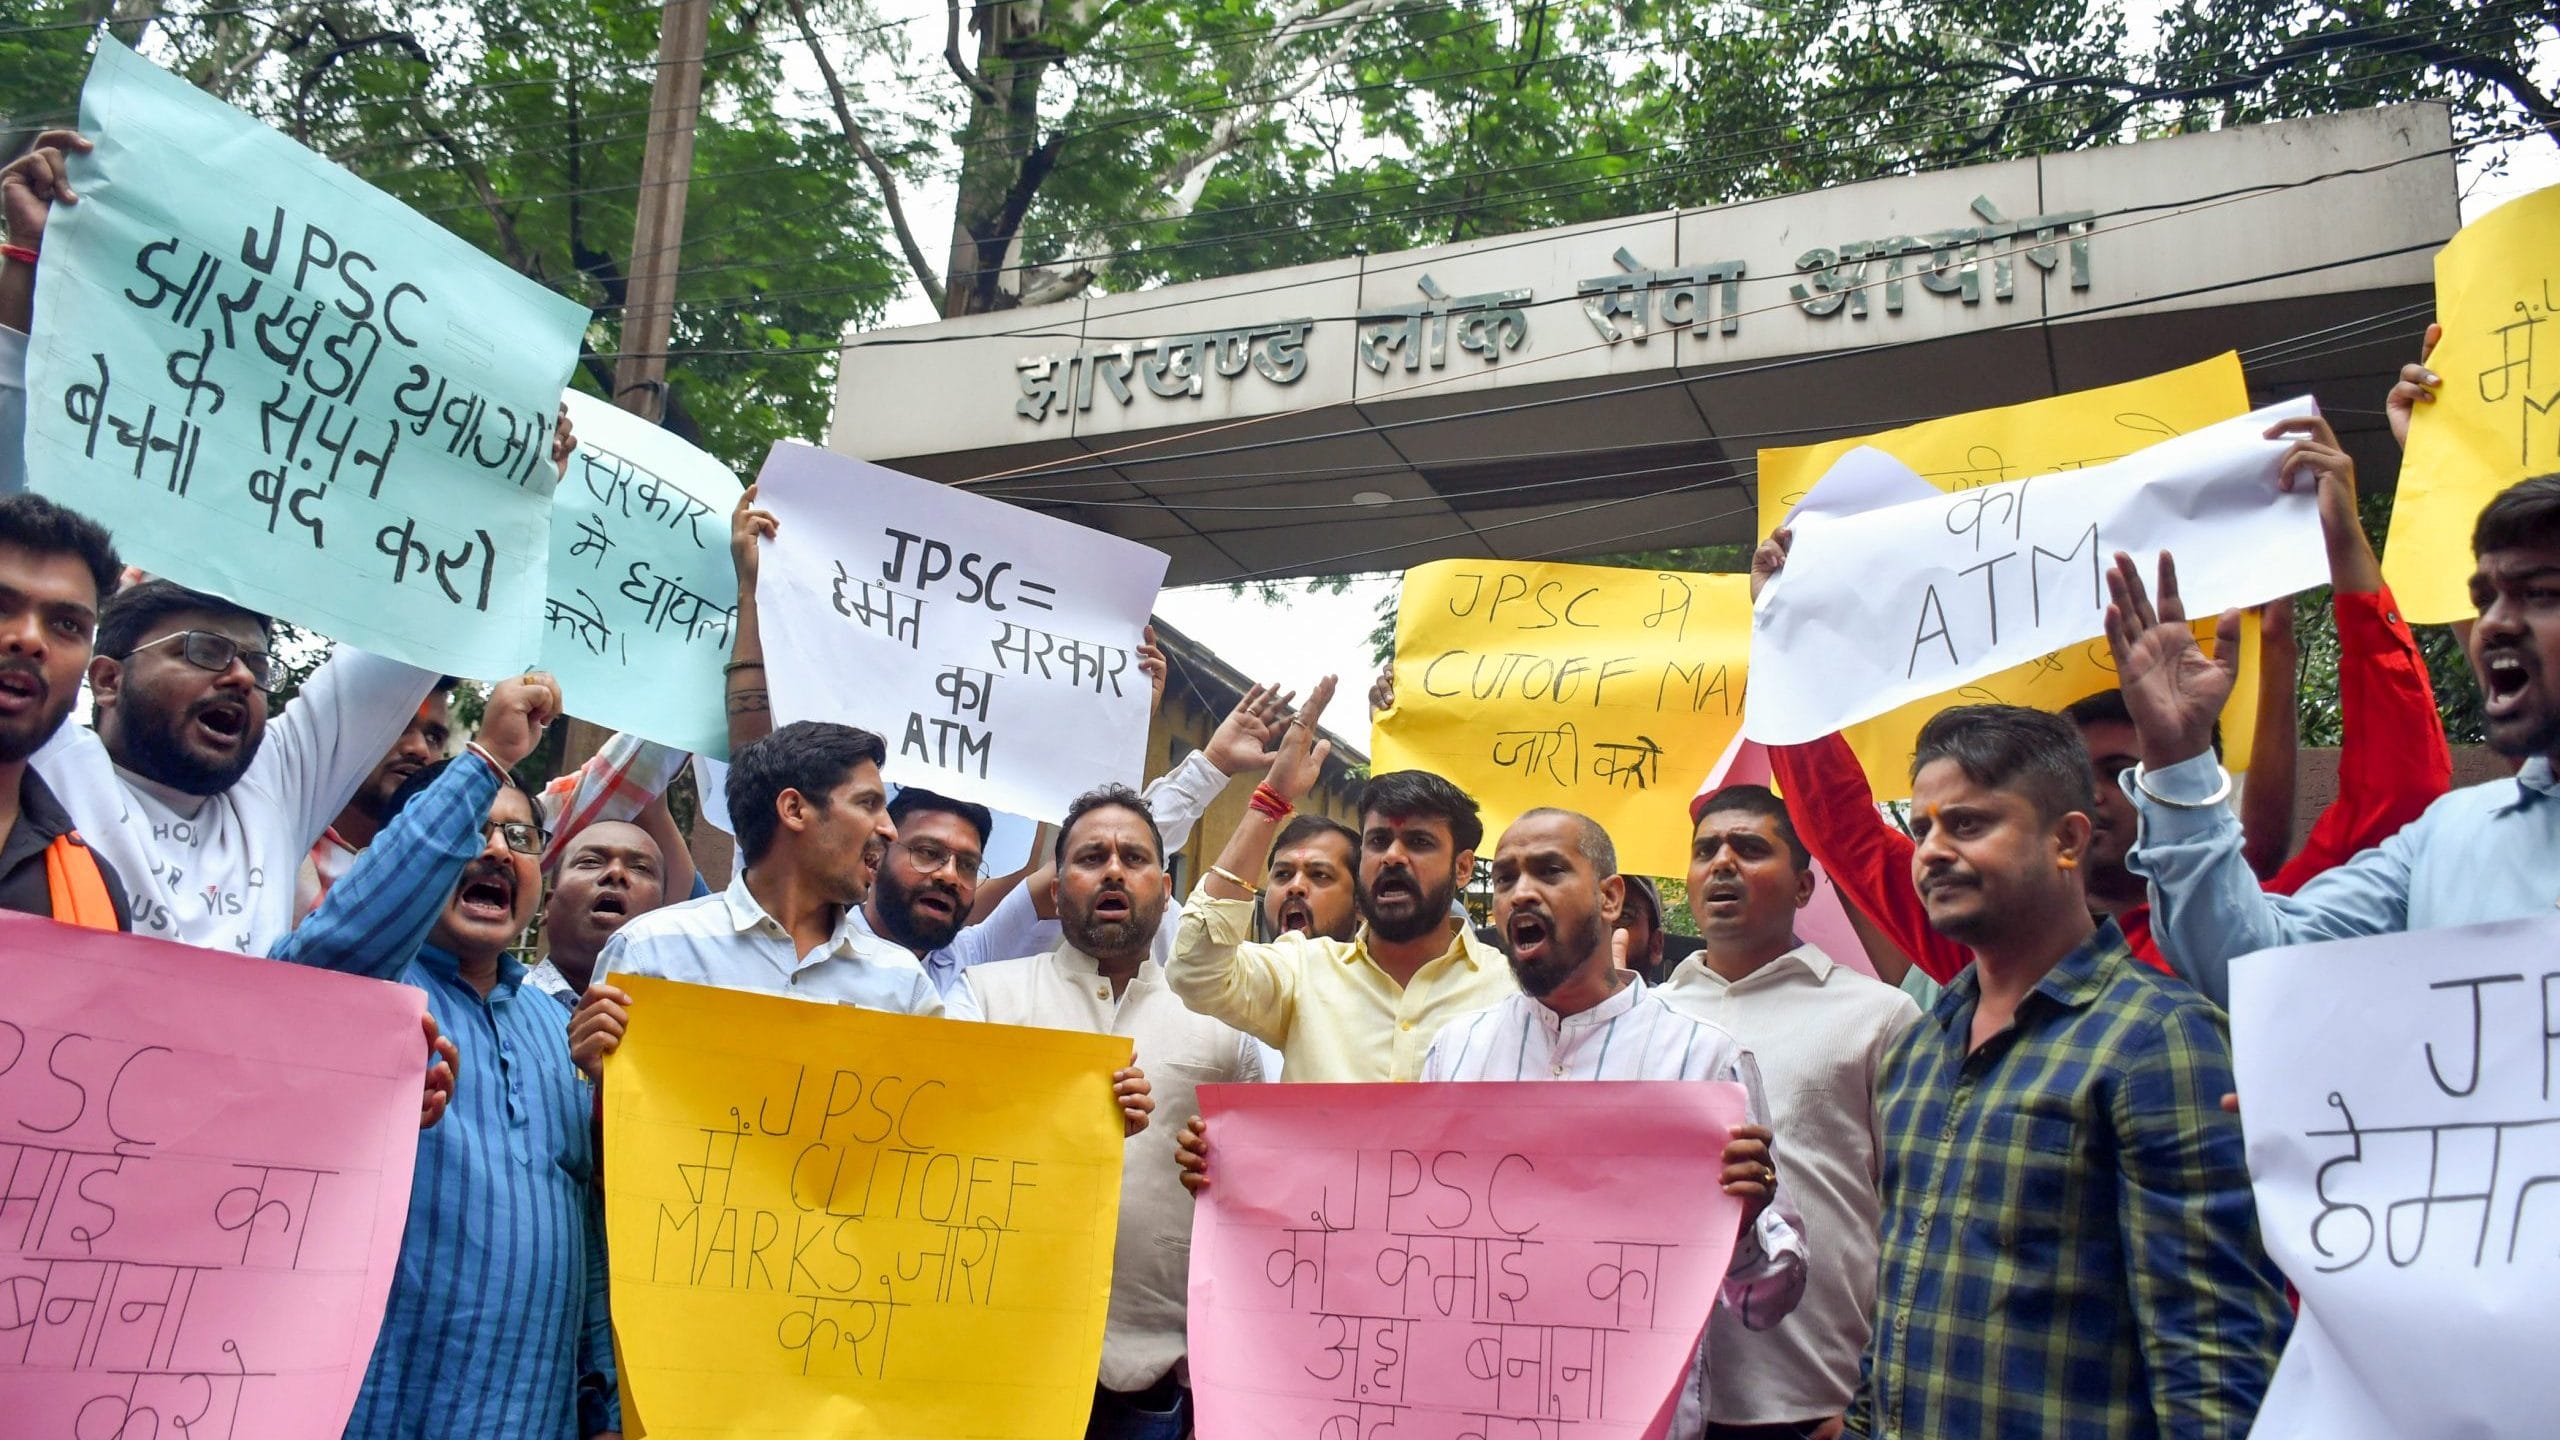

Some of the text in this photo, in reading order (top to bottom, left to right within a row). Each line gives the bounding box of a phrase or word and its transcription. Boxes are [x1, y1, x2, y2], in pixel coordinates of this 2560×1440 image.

[124, 237, 382, 406] झारखंडी
[241, 206, 428, 348] JPSC
[1016, 194, 2095, 421] झारखण्ड लोक सेवा आयोग
[167, 328, 400, 500] के सपने
[64, 353, 496, 611] बेचना बंद करो
[581, 441, 717, 549] सरकार
[1946, 477, 2031, 552] का
[831, 559, 1129, 698] हेमंत सरकार
[1449, 573, 1600, 629] JPSC
[1908, 522, 2101, 679] ATM
[936, 664, 1005, 722] का
[1423, 650, 1750, 716] CUTOFF MA
[901, 712, 993, 780] ATM
[1493, 722, 1579, 787] जारी
[759, 1064, 946, 1149] JPSC
[215, 1164, 340, 1270] का
[678, 1106, 1039, 1228] में CUTOFF
[1319, 1149, 1541, 1236] JPSC
[652, 1203, 1021, 1306] MARKS जारी
[1266, 1210, 1680, 1331] को कमाई का
[778, 1275, 911, 1380] करो
[1465, 1321, 1631, 1420] बनाना
